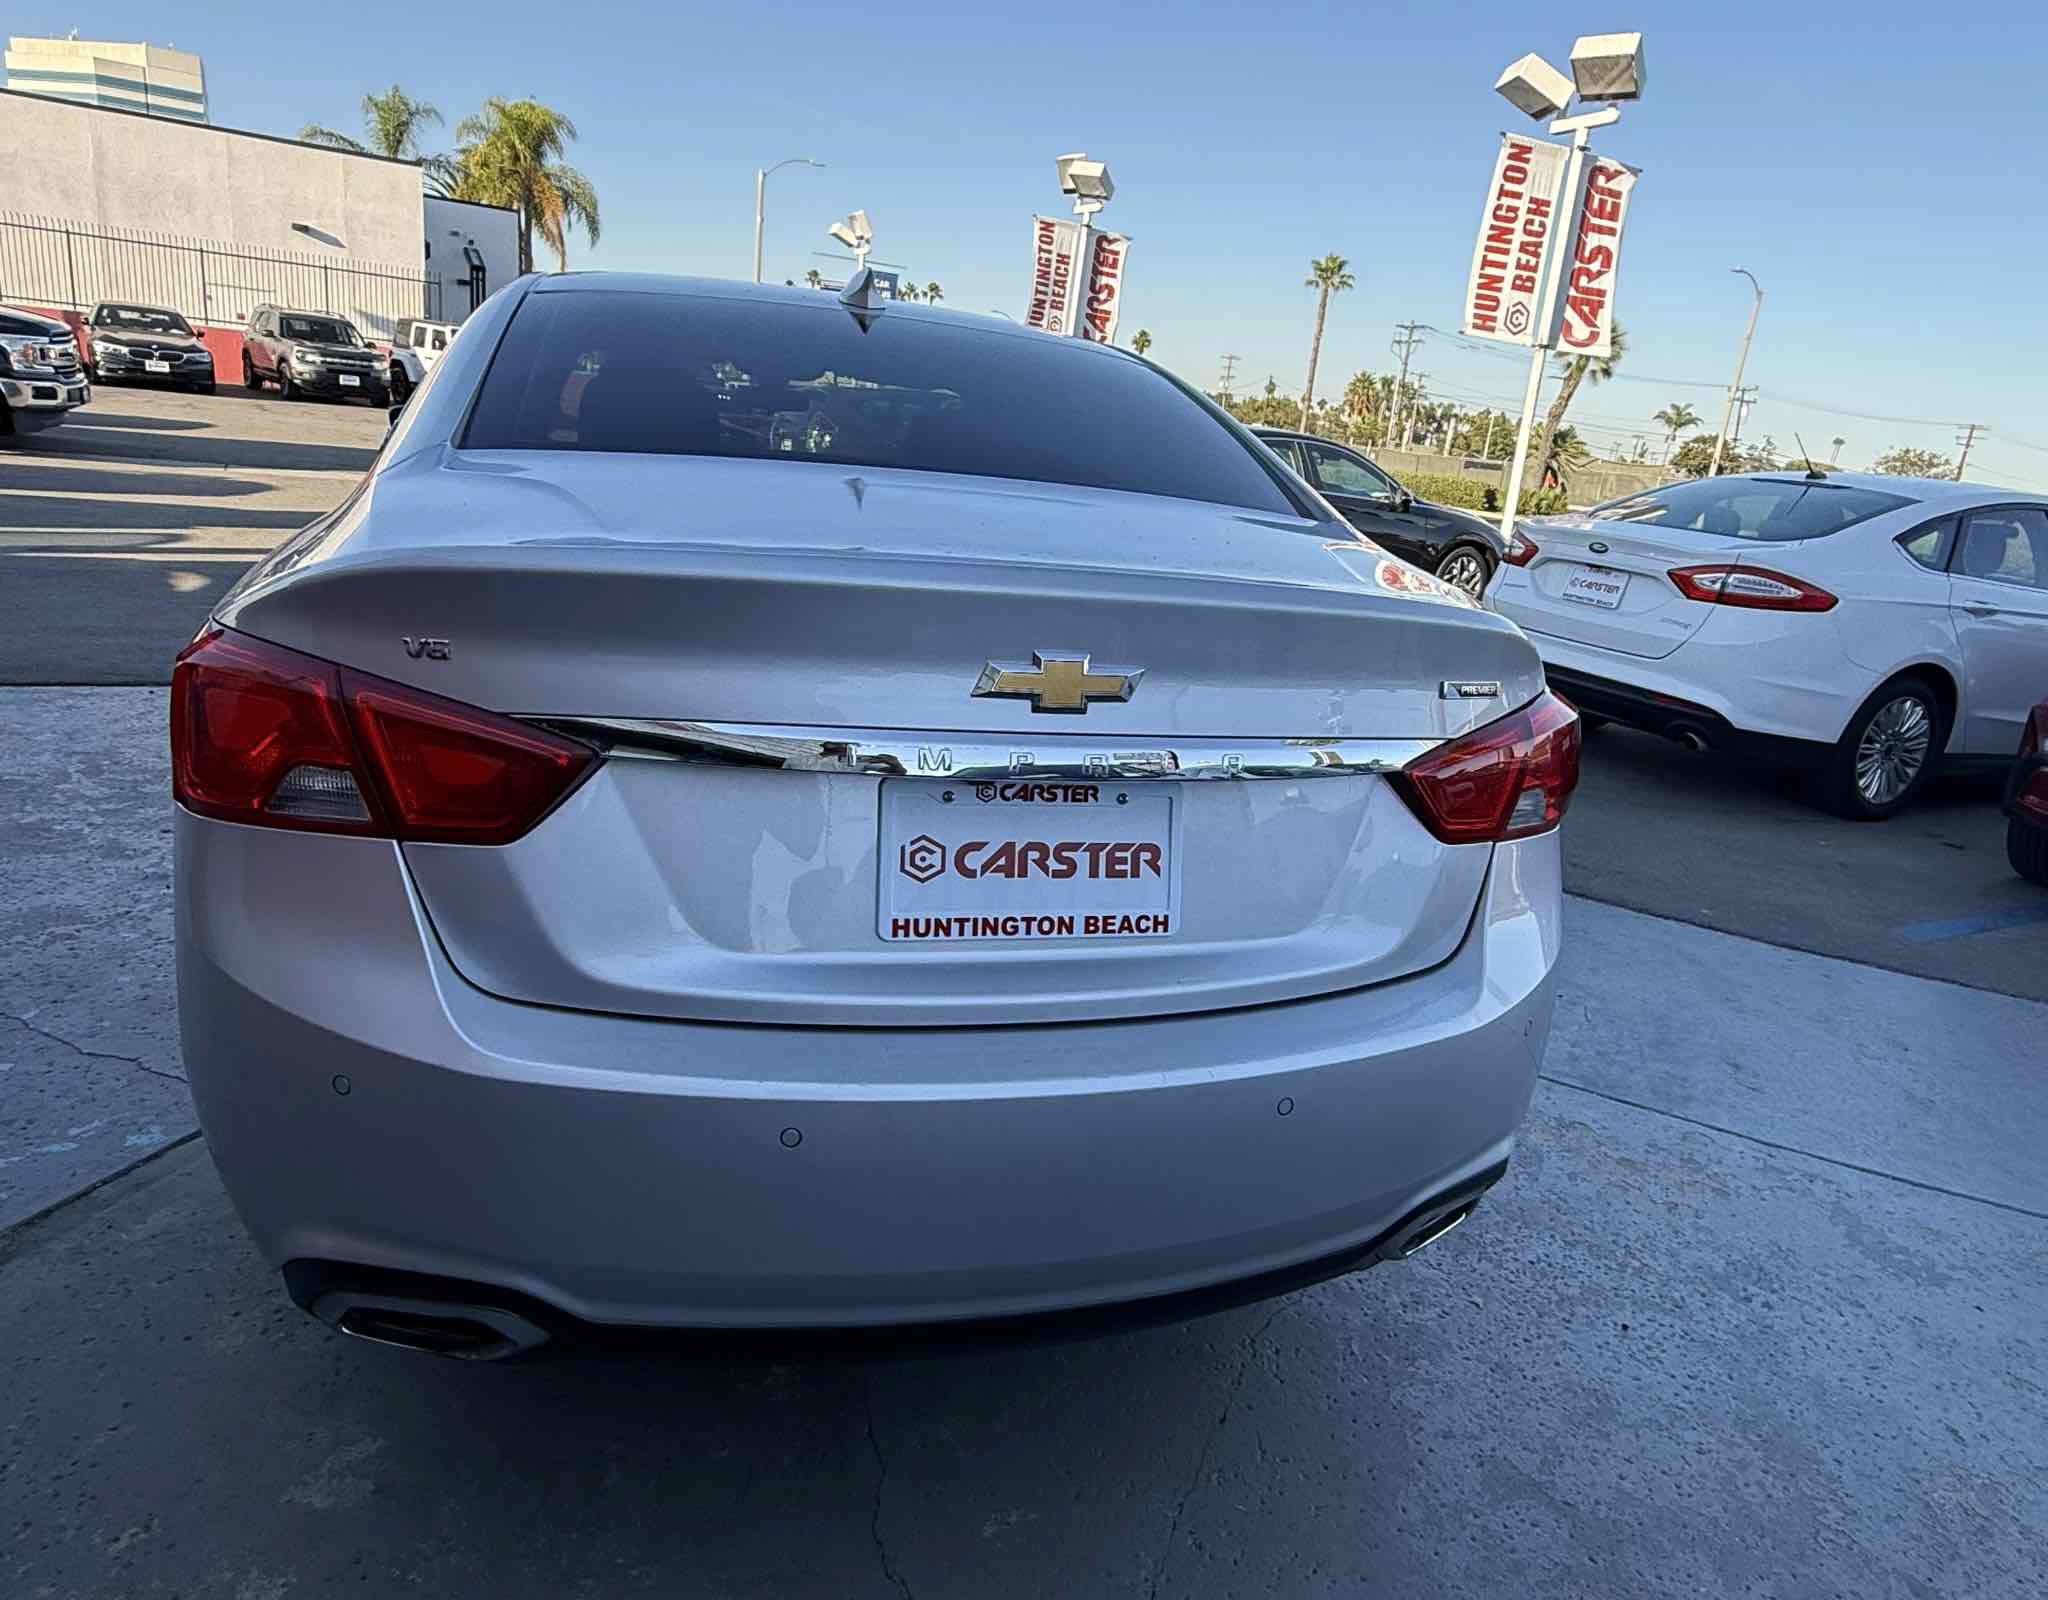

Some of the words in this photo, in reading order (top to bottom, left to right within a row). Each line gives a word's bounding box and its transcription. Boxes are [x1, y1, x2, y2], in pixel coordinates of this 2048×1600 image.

[1472, 142, 1533, 333] HUNTINGTON
[1511, 195, 1552, 295] BEACH
[1561, 163, 1627, 348] CARSTER
[1050, 252, 1072, 312] BEACH
[400, 636, 451, 660] V6
[999, 783, 1100, 804] CARSTER
[954, 840, 1162, 879] CARSTER
[891, 915, 1075, 938] HUNTINGTON
[1083, 914, 1170, 935] BEACH
